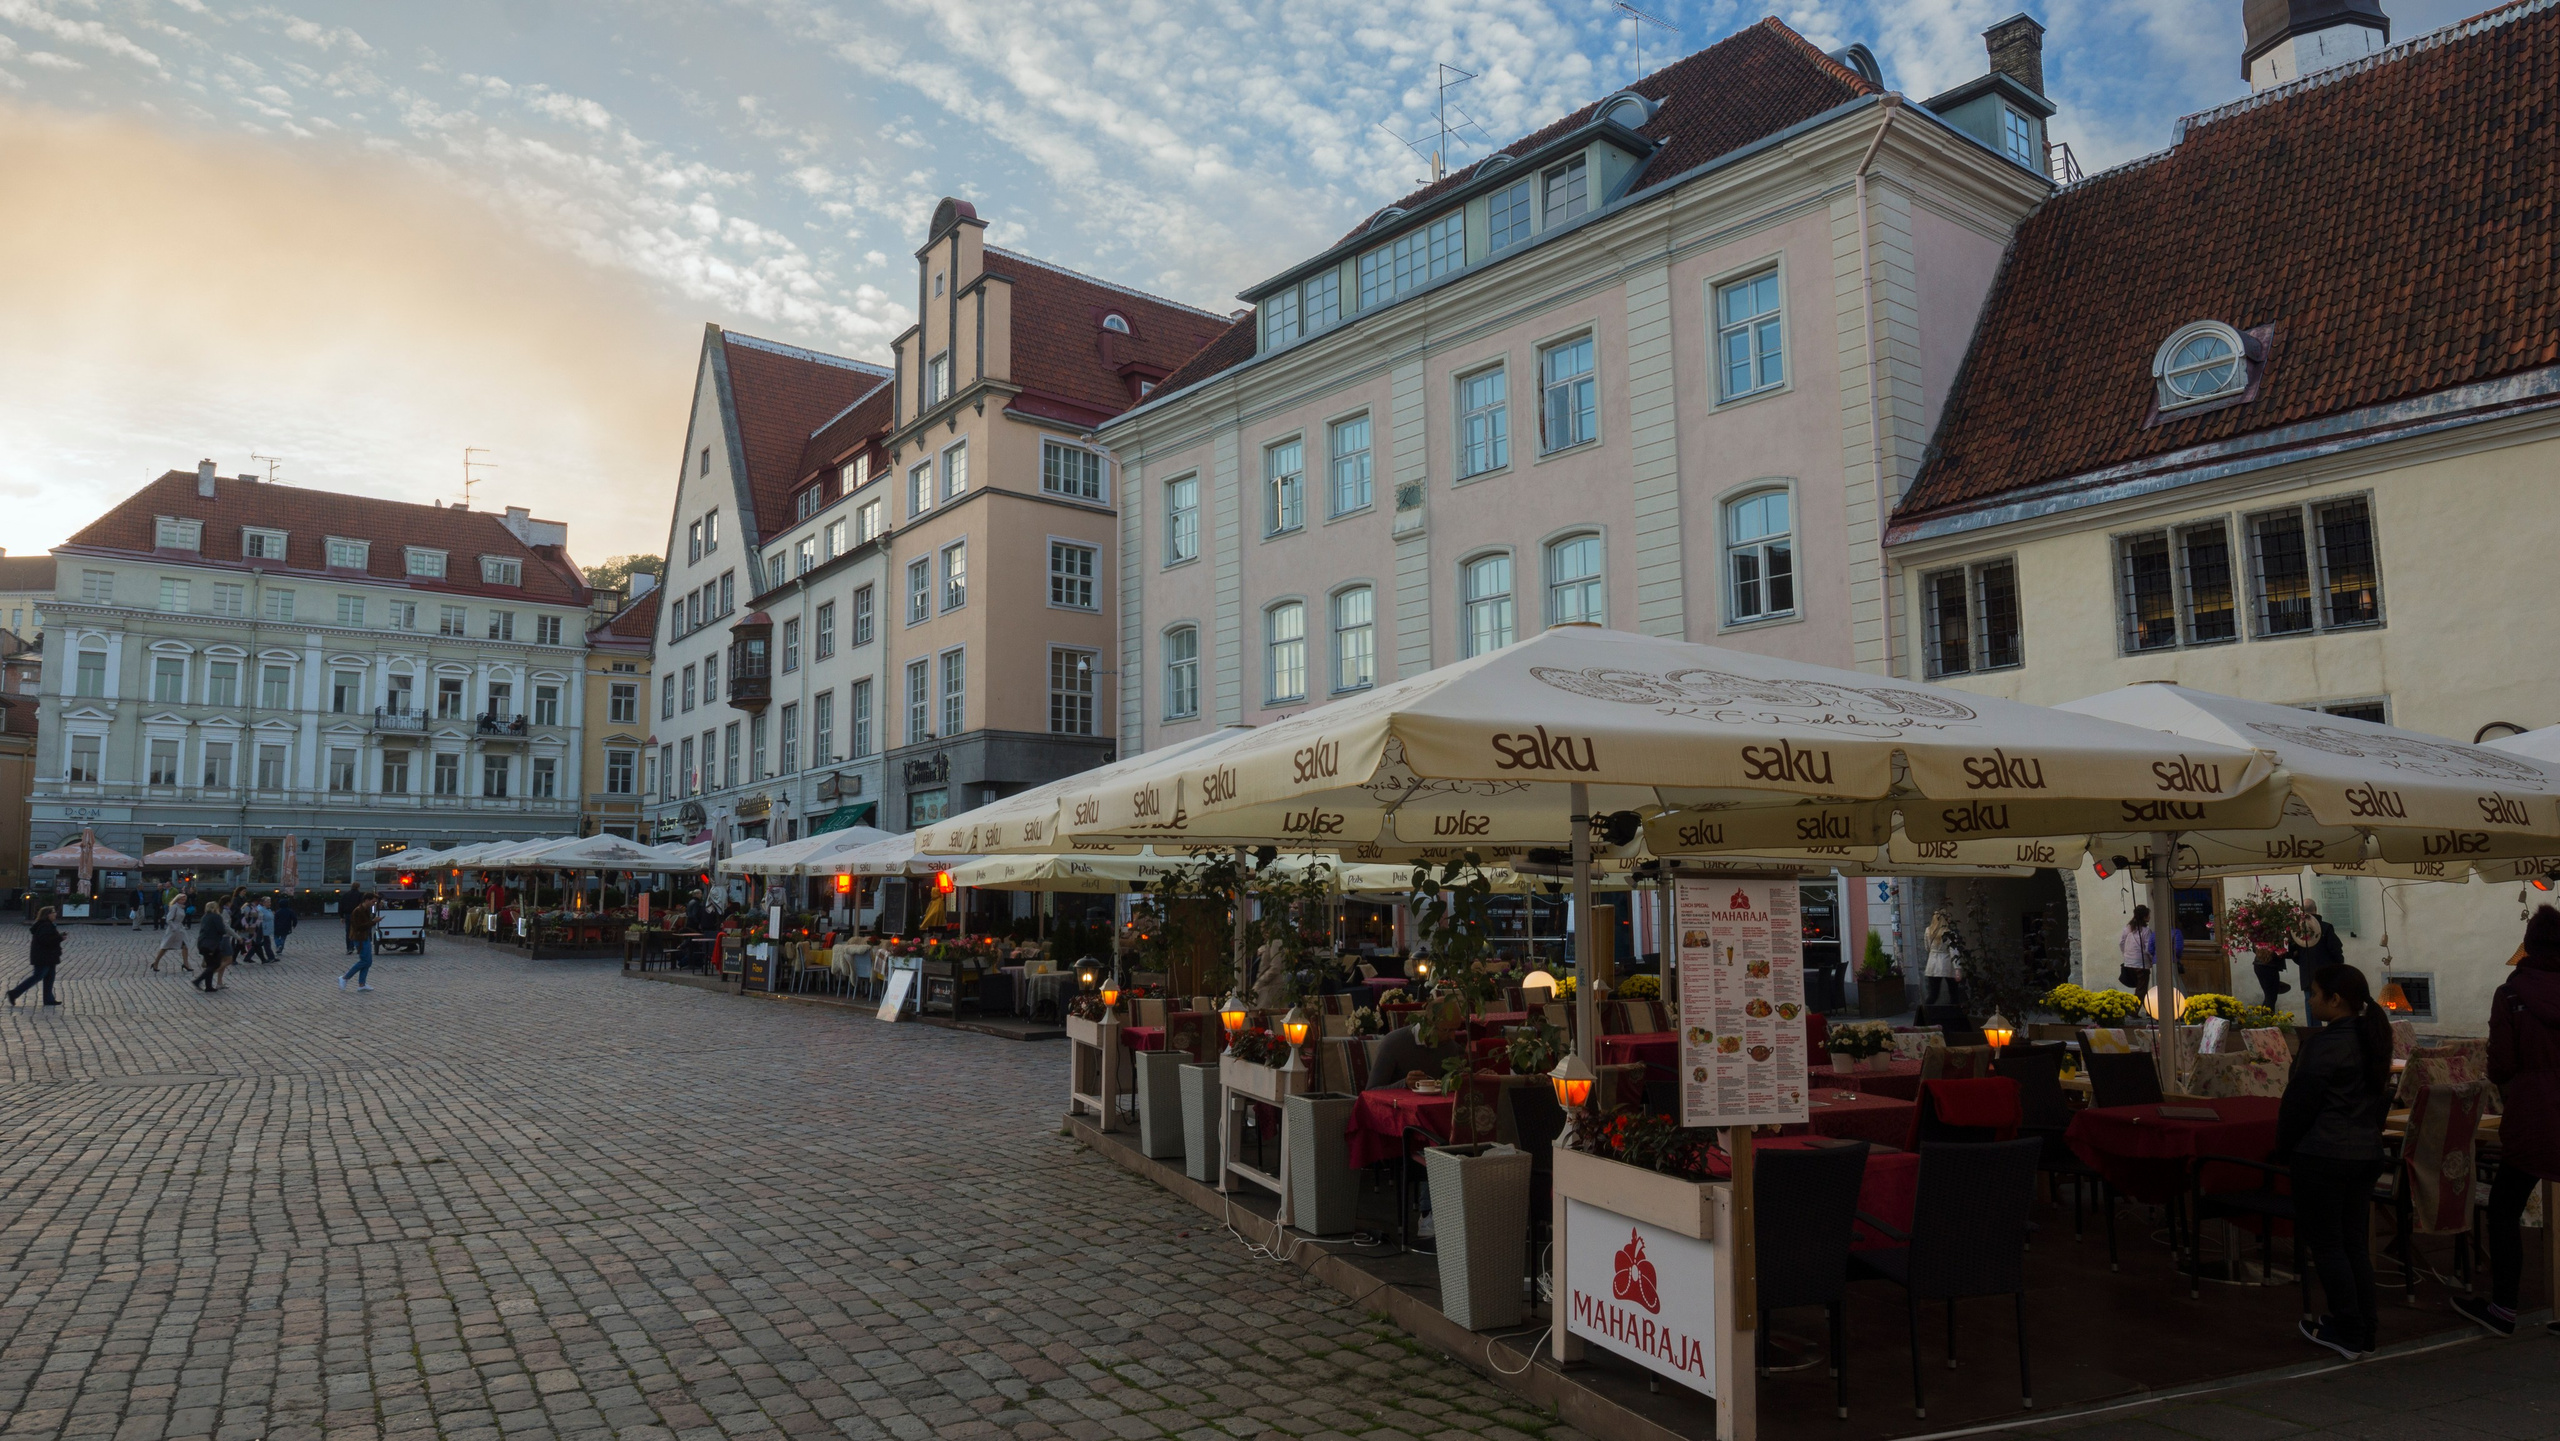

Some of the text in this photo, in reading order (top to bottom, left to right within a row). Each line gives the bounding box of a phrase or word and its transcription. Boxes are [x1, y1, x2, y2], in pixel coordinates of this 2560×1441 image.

[1294, 736, 1339, 784] saku
[1492, 724, 1599, 772] saku
[1742, 738, 1834, 784] saku
[1963, 747, 2047, 789] saku
[2152, 753, 2223, 794] saku
[1134, 782, 1160, 818] saku
[1203, 763, 1237, 807] saku
[2345, 781, 2407, 818] saku
[1074, 794, 1100, 826] saku
[1796, 810, 1850, 839] saku
[1942, 800, 2010, 833] saku
[2478, 791, 2530, 826] saku
[949, 827, 965, 848] saku
[985, 823, 1001, 847] saku
[1024, 816, 1042, 842] saku
[1678, 818, 1724, 846] saku
[1357, 841, 1384, 859] saku
[928, 861, 951, 872] saku
[1071, 862, 1093, 874] Puls
[1139, 865, 1160, 877] Puls
[1711, 911, 1768, 922] MAHARAJA
[1573, 1288, 1706, 1380] MAHARAJA
